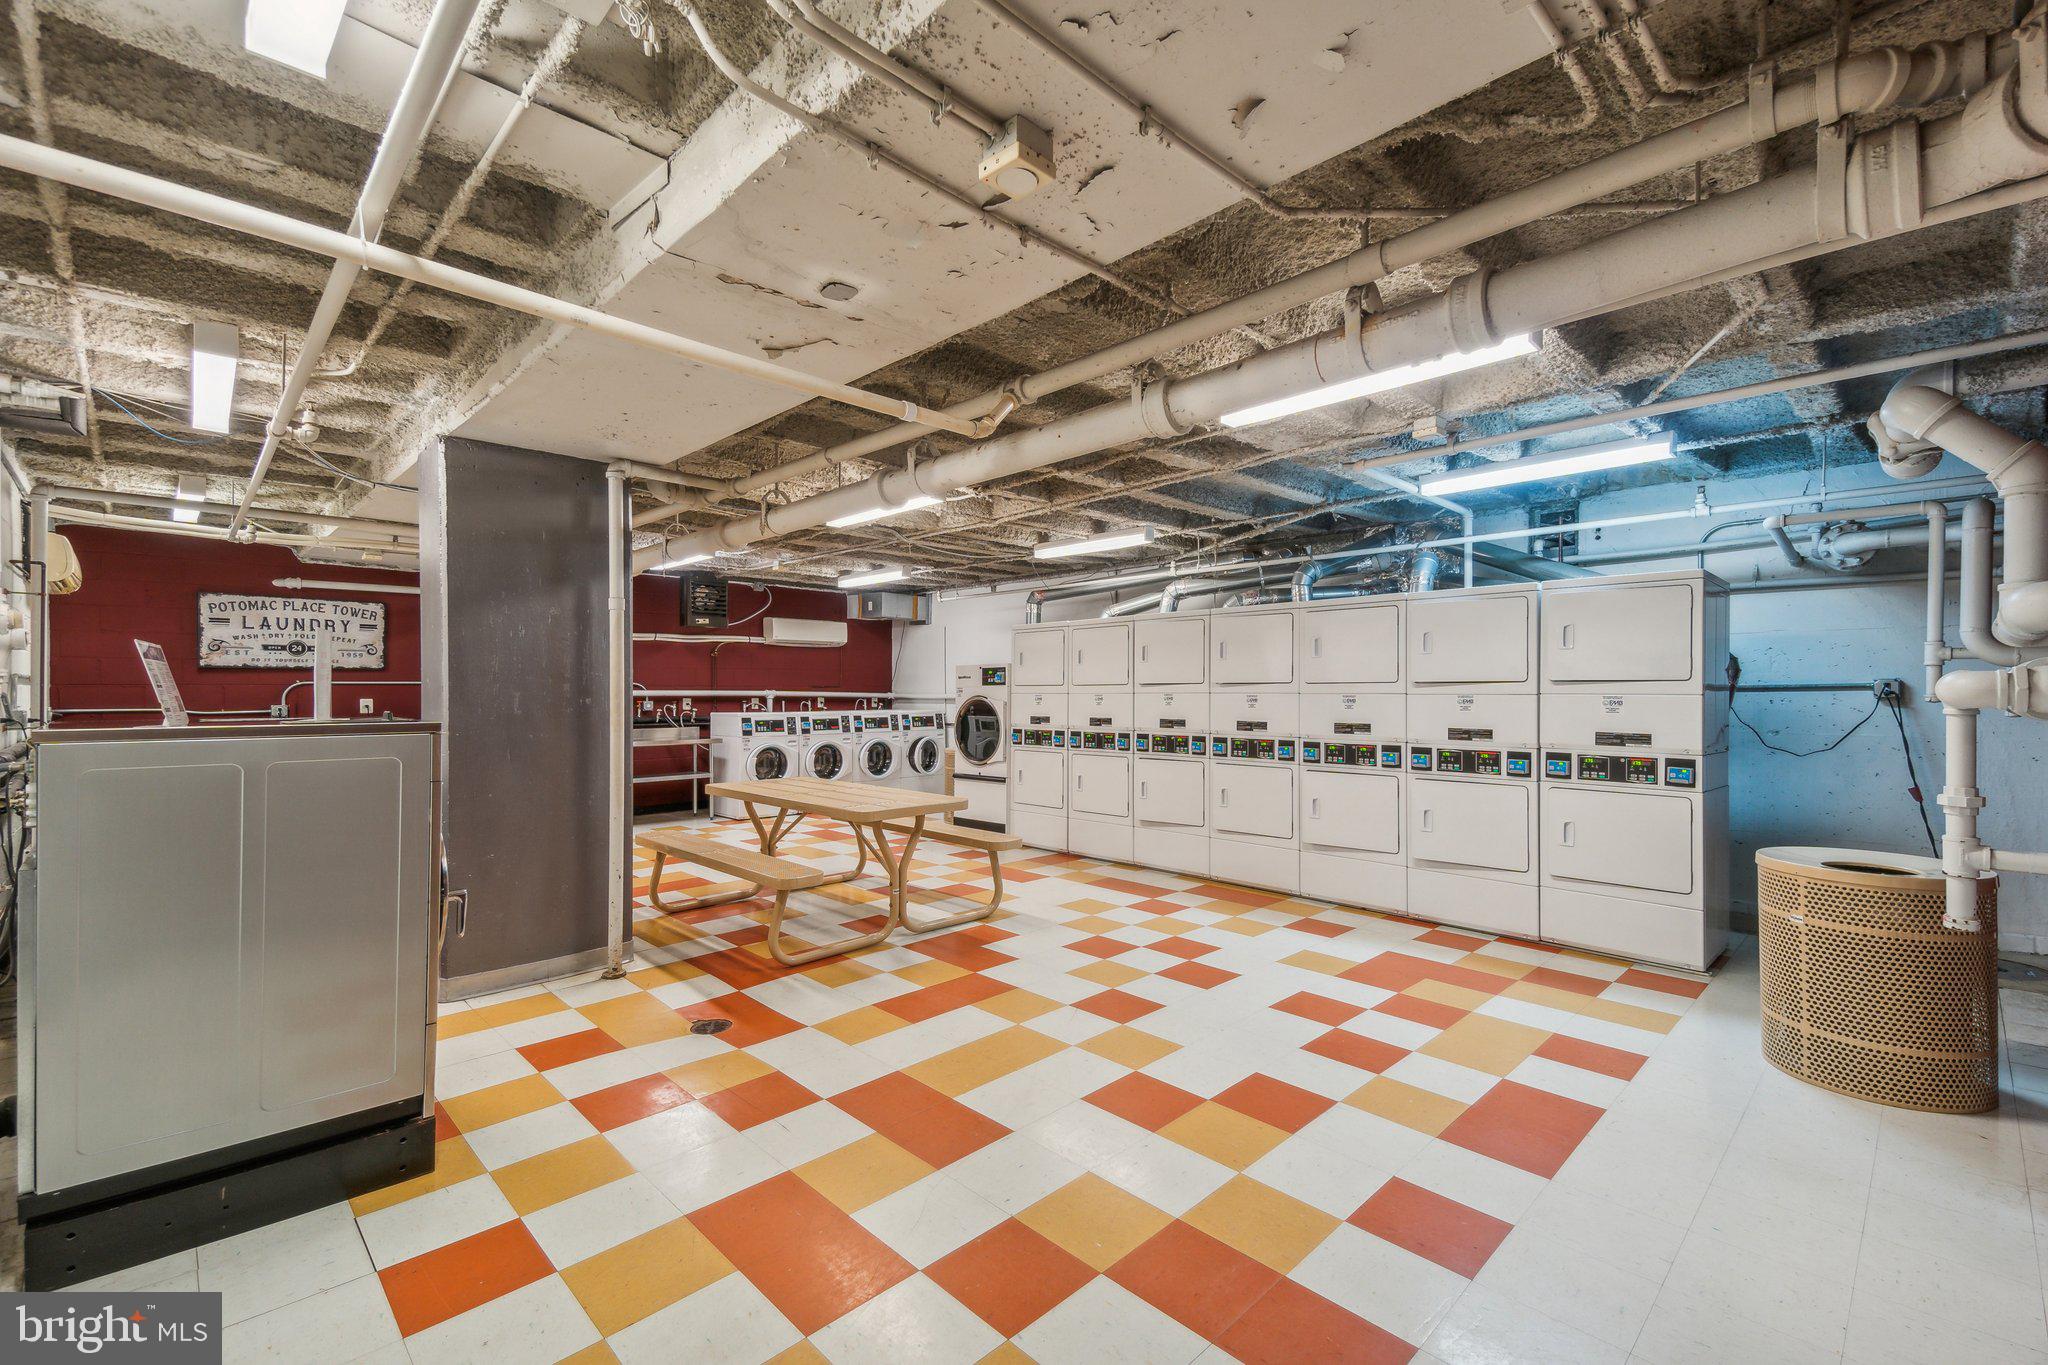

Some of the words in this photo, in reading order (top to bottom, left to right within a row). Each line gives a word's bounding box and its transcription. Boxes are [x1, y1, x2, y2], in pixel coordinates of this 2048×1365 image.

[208, 600, 278, 614] POTOMAC
[283, 600, 326, 614] PLACE
[332, 604, 378, 621] TOWER
[241, 615, 351, 633] LAUNDRY
[331, 636, 357, 644] EPEAT
[291, 644, 302, 652] 24
